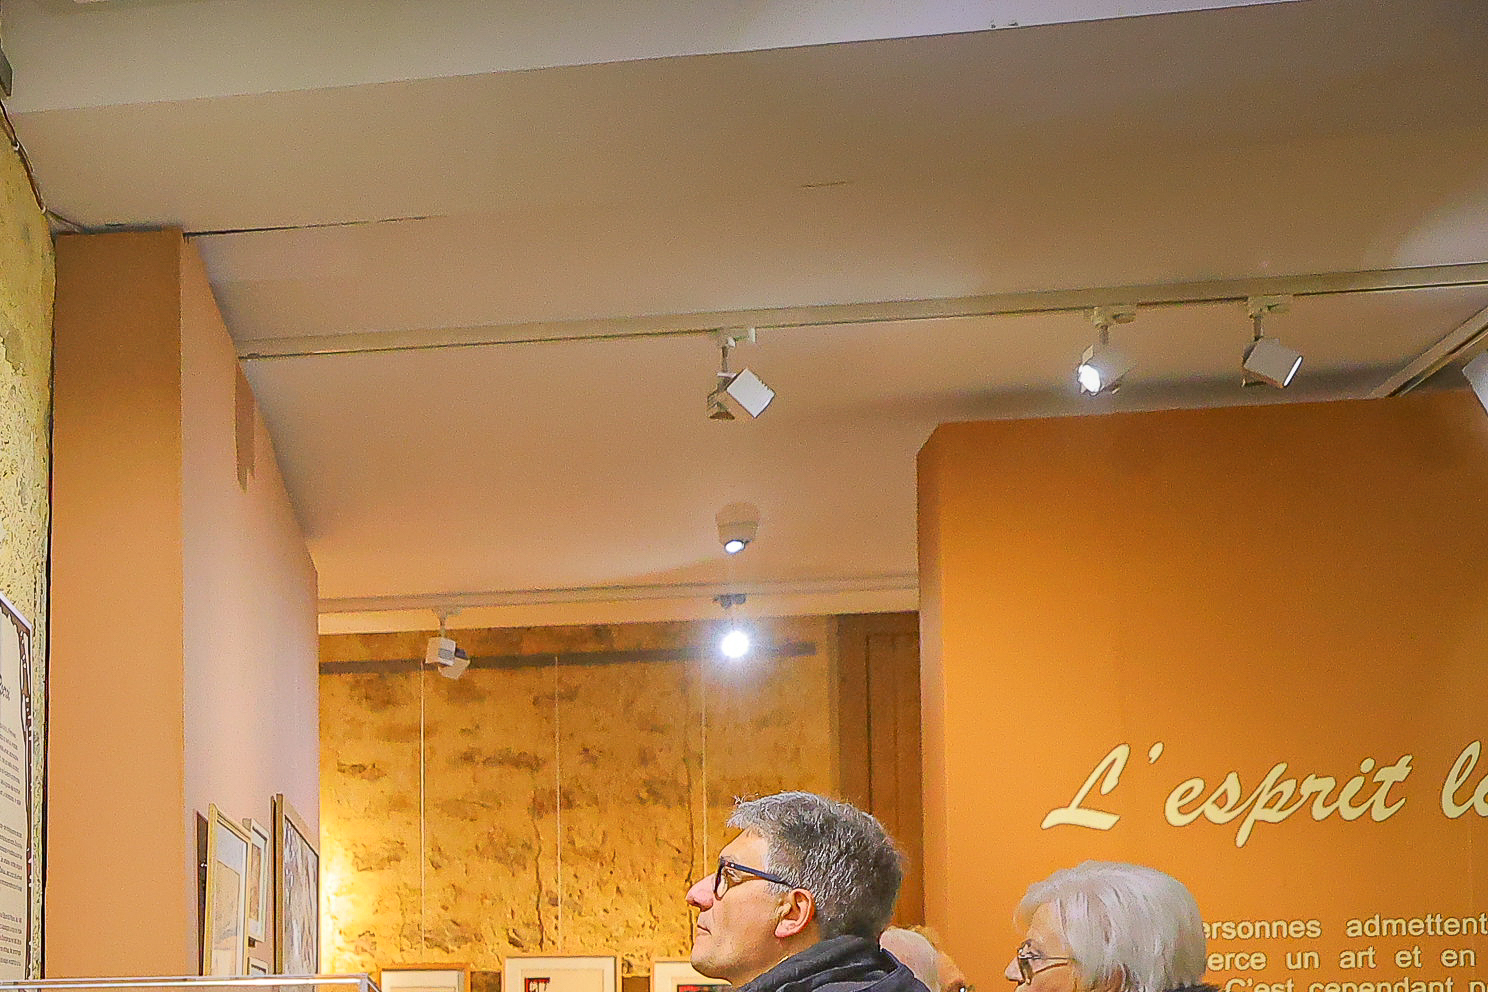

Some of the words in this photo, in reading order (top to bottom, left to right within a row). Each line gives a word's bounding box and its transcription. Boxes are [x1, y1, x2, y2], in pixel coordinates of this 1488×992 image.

[1041, 741, 1413, 848] L'esprit
[1202, 919, 1322, 939] ersonnes
[1346, 913, 1488, 937] admettent
[1207, 951, 1267, 971] erce
[1285, 950, 1320, 970] un
[1339, 946, 1377, 968] art
[1394, 945, 1422, 968] et
[1441, 948, 1476, 968] en
